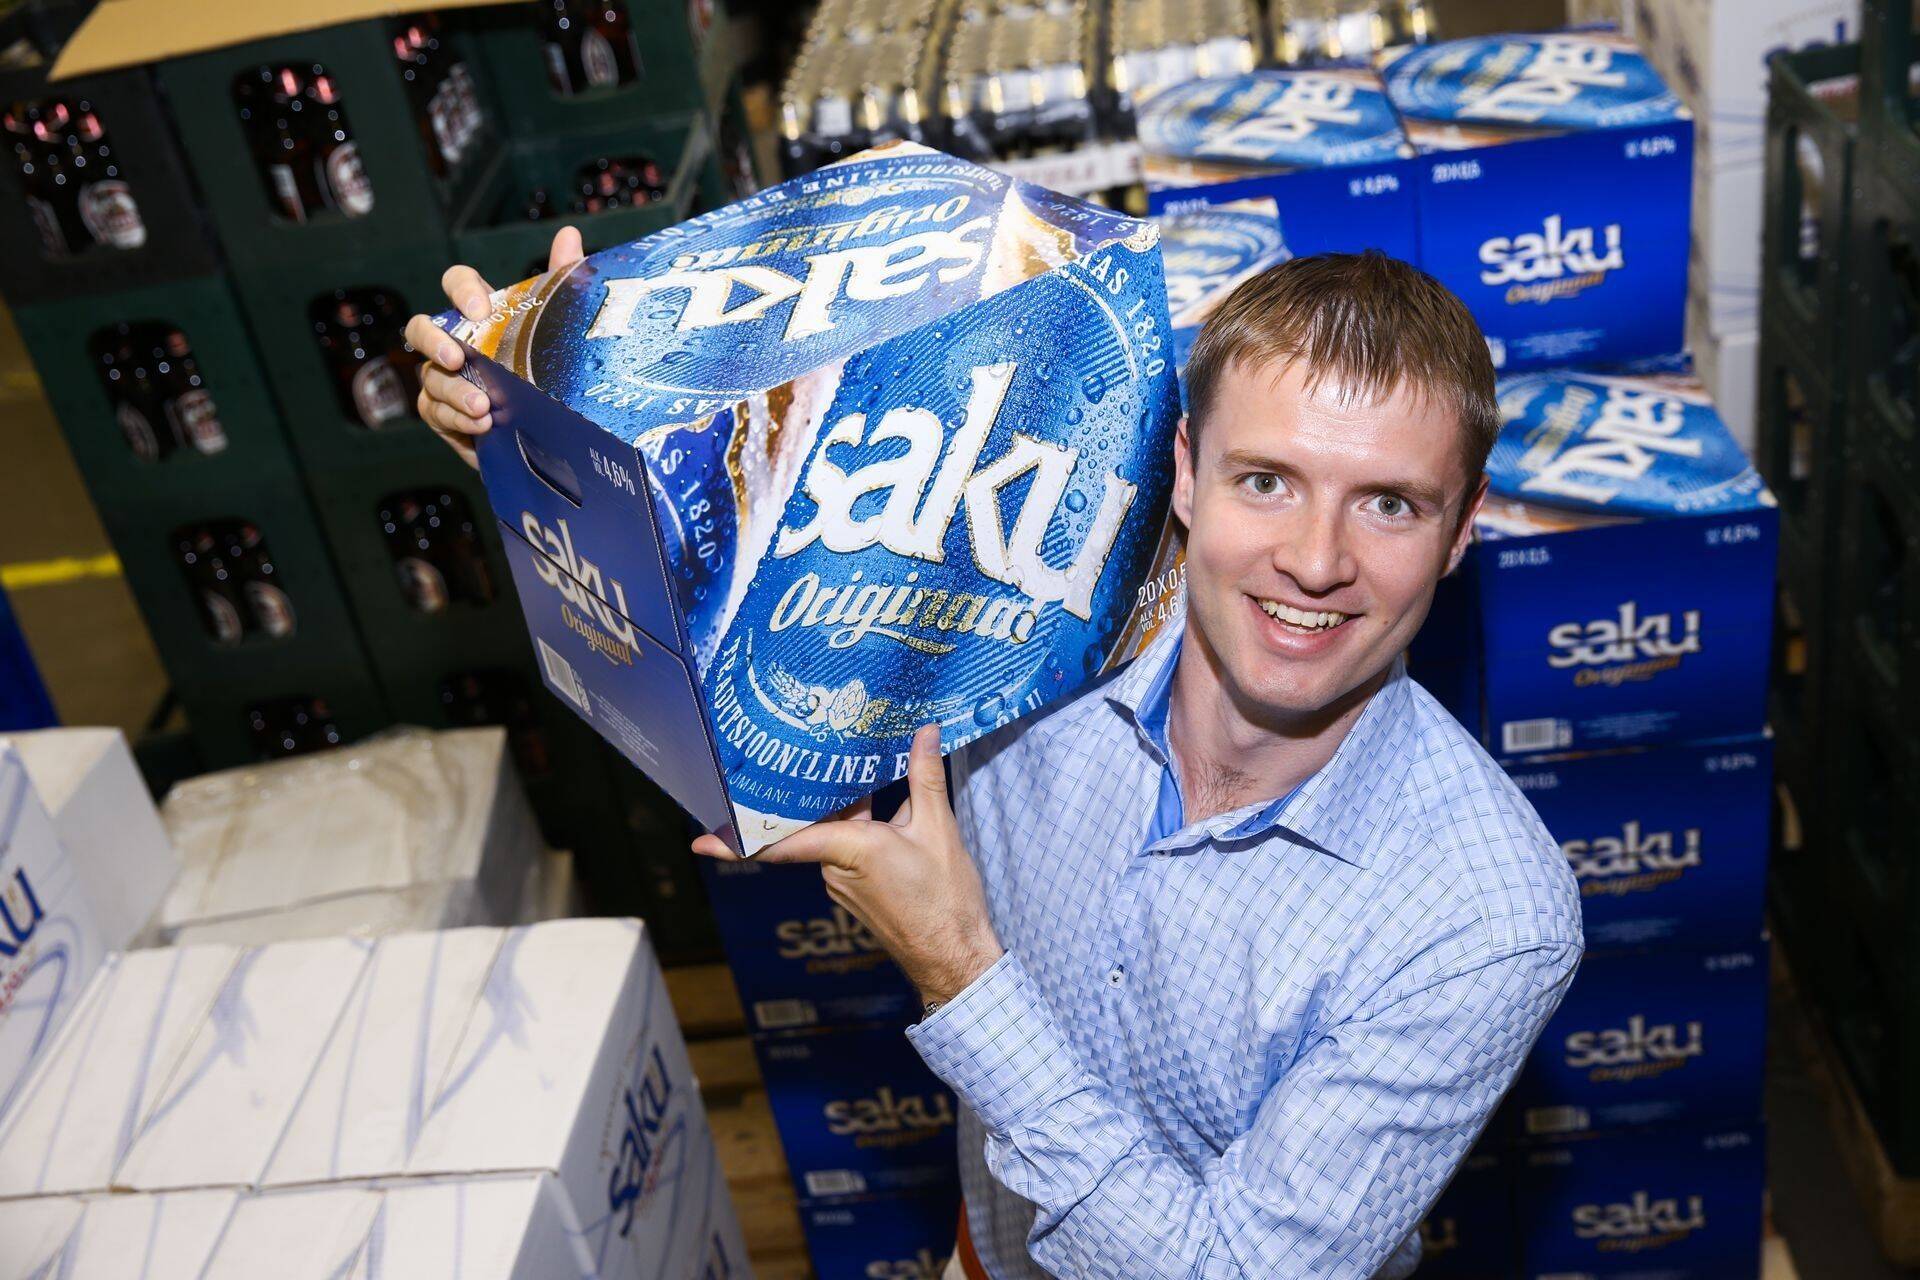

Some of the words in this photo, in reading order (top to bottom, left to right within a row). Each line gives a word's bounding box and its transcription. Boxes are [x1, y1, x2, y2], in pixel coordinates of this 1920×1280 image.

[585, 217, 995, 343] saku
[1479, 214, 1624, 286] saku
[1126, 297, 1166, 377] 1820
[584, 381, 655, 413] 1820
[603, 455, 636, 496] 4,6%
[774, 361, 1138, 623] saku
[680, 480, 718, 560] 1820
[521, 510, 643, 657] saku
[559, 603, 634, 666] Originaal
[1547, 600, 1701, 669] saku
[713, 636, 881, 784] TRADITSIOONILINE
[724, 766, 795, 805] UMALANE
[1561, 819, 1702, 879] saku
[775, 904, 884, 960] sak
[1564, 1014, 1704, 1069] saku
[609, 1043, 672, 1238] saku
[824, 1085, 956, 1137] saku
[1572, 1190, 1706, 1240] saku
